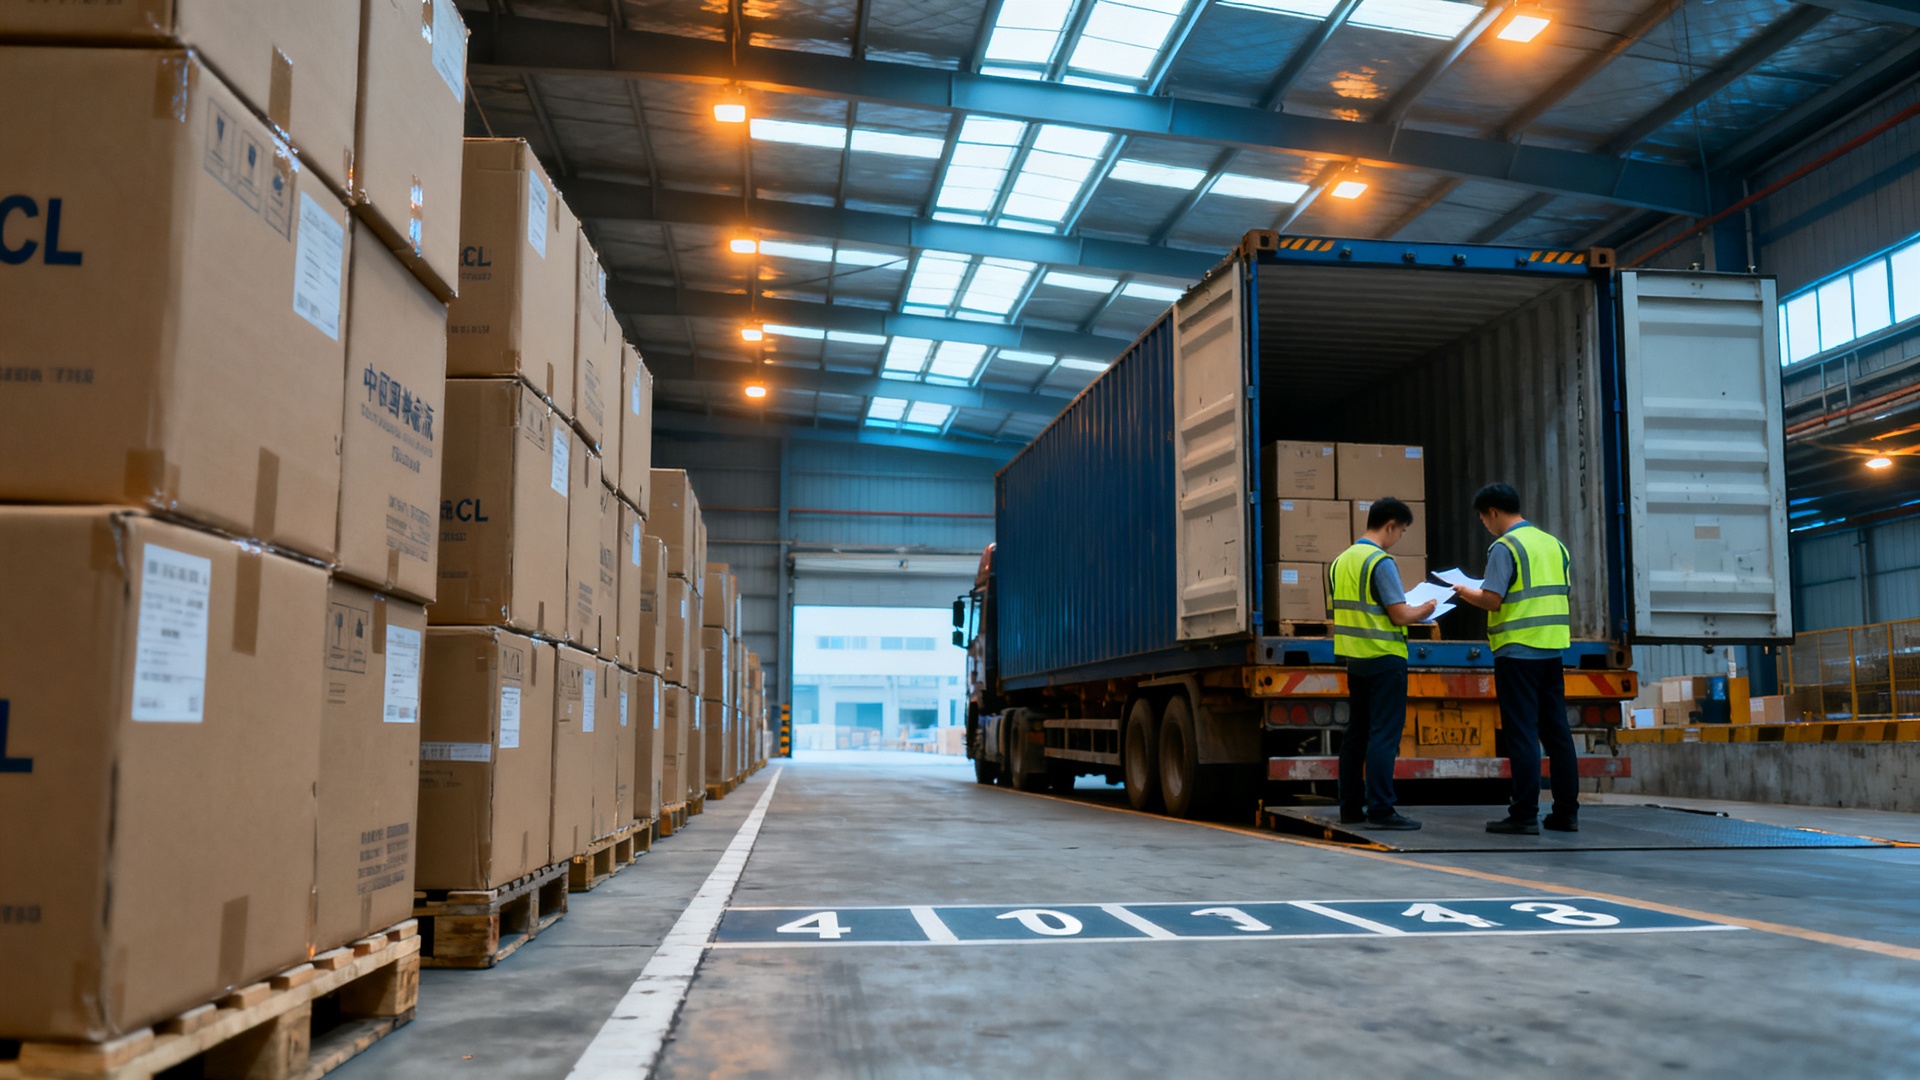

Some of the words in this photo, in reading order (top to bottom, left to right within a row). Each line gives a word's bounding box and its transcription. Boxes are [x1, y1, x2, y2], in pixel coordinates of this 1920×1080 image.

[0, 194, 83, 267] CL
[461, 245, 492, 267] CL
[776, 910, 851, 939] 4
